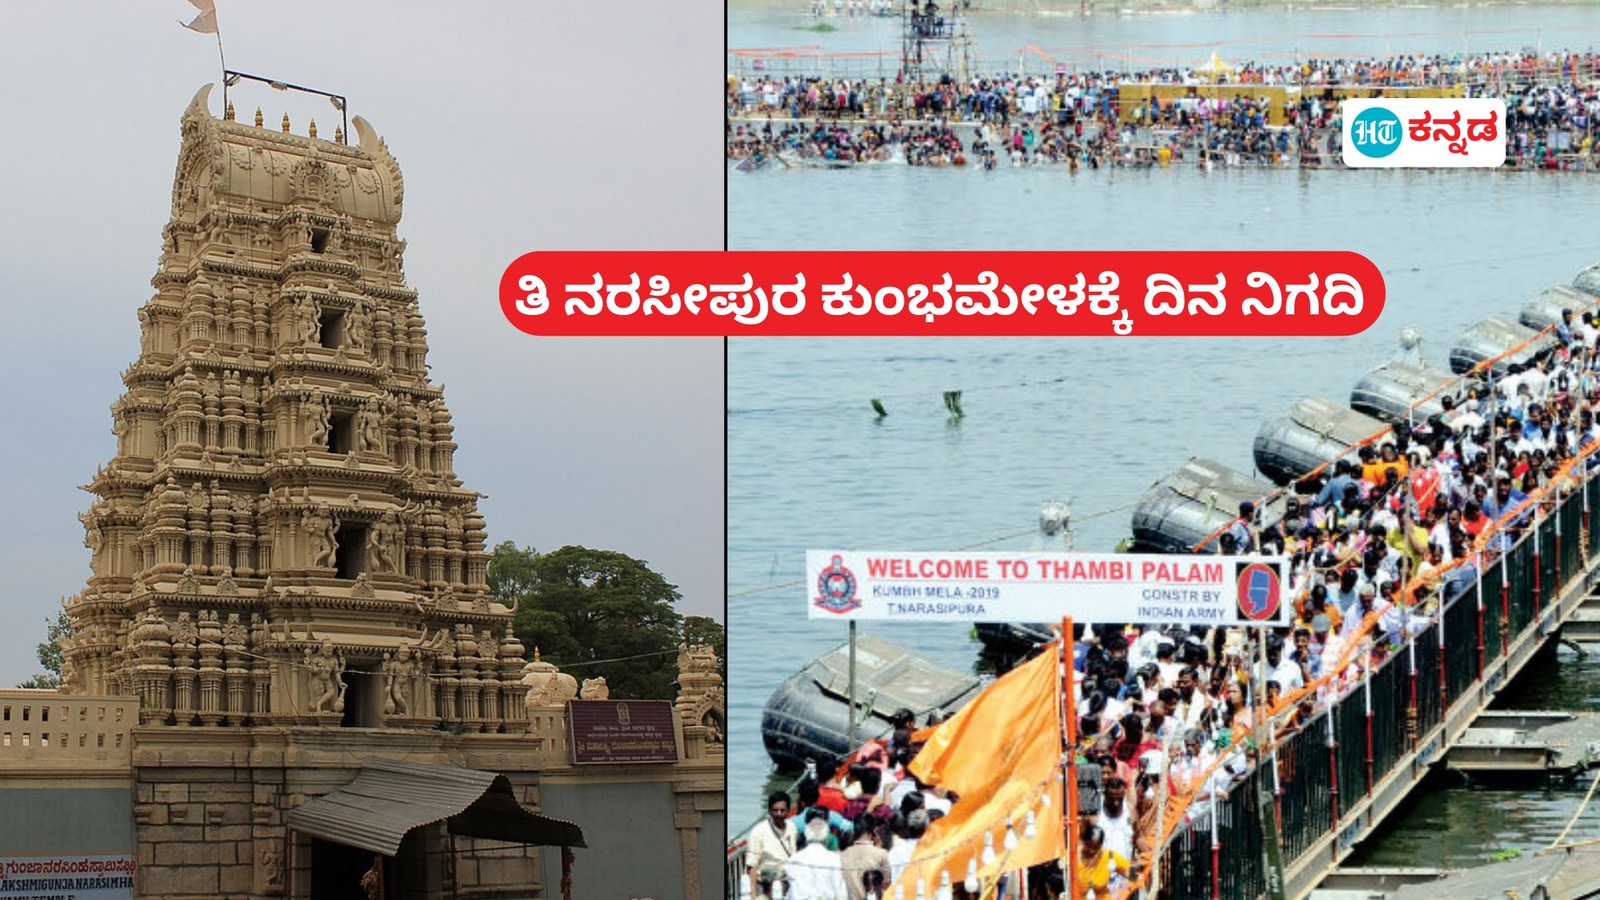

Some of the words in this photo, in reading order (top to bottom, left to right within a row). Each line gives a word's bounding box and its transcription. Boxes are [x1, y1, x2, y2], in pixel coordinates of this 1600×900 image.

[867, 558, 988, 579] WELCOME
[997, 560, 1029, 579] TO
[1037, 561, 1132, 581] THAMBI
[1142, 561, 1223, 583] PALAM
[873, 586, 920, 597] KUMBH
[925, 586, 962, 598] MELA
[1142, 589, 1199, 602] CONSTR
[1203, 591, 1222, 602] BY
[1137, 606, 1184, 618] INDIAN
[1187, 607, 1226, 620] ARMY
[0, 878, 74, 891] AKSHMIGUNJA
